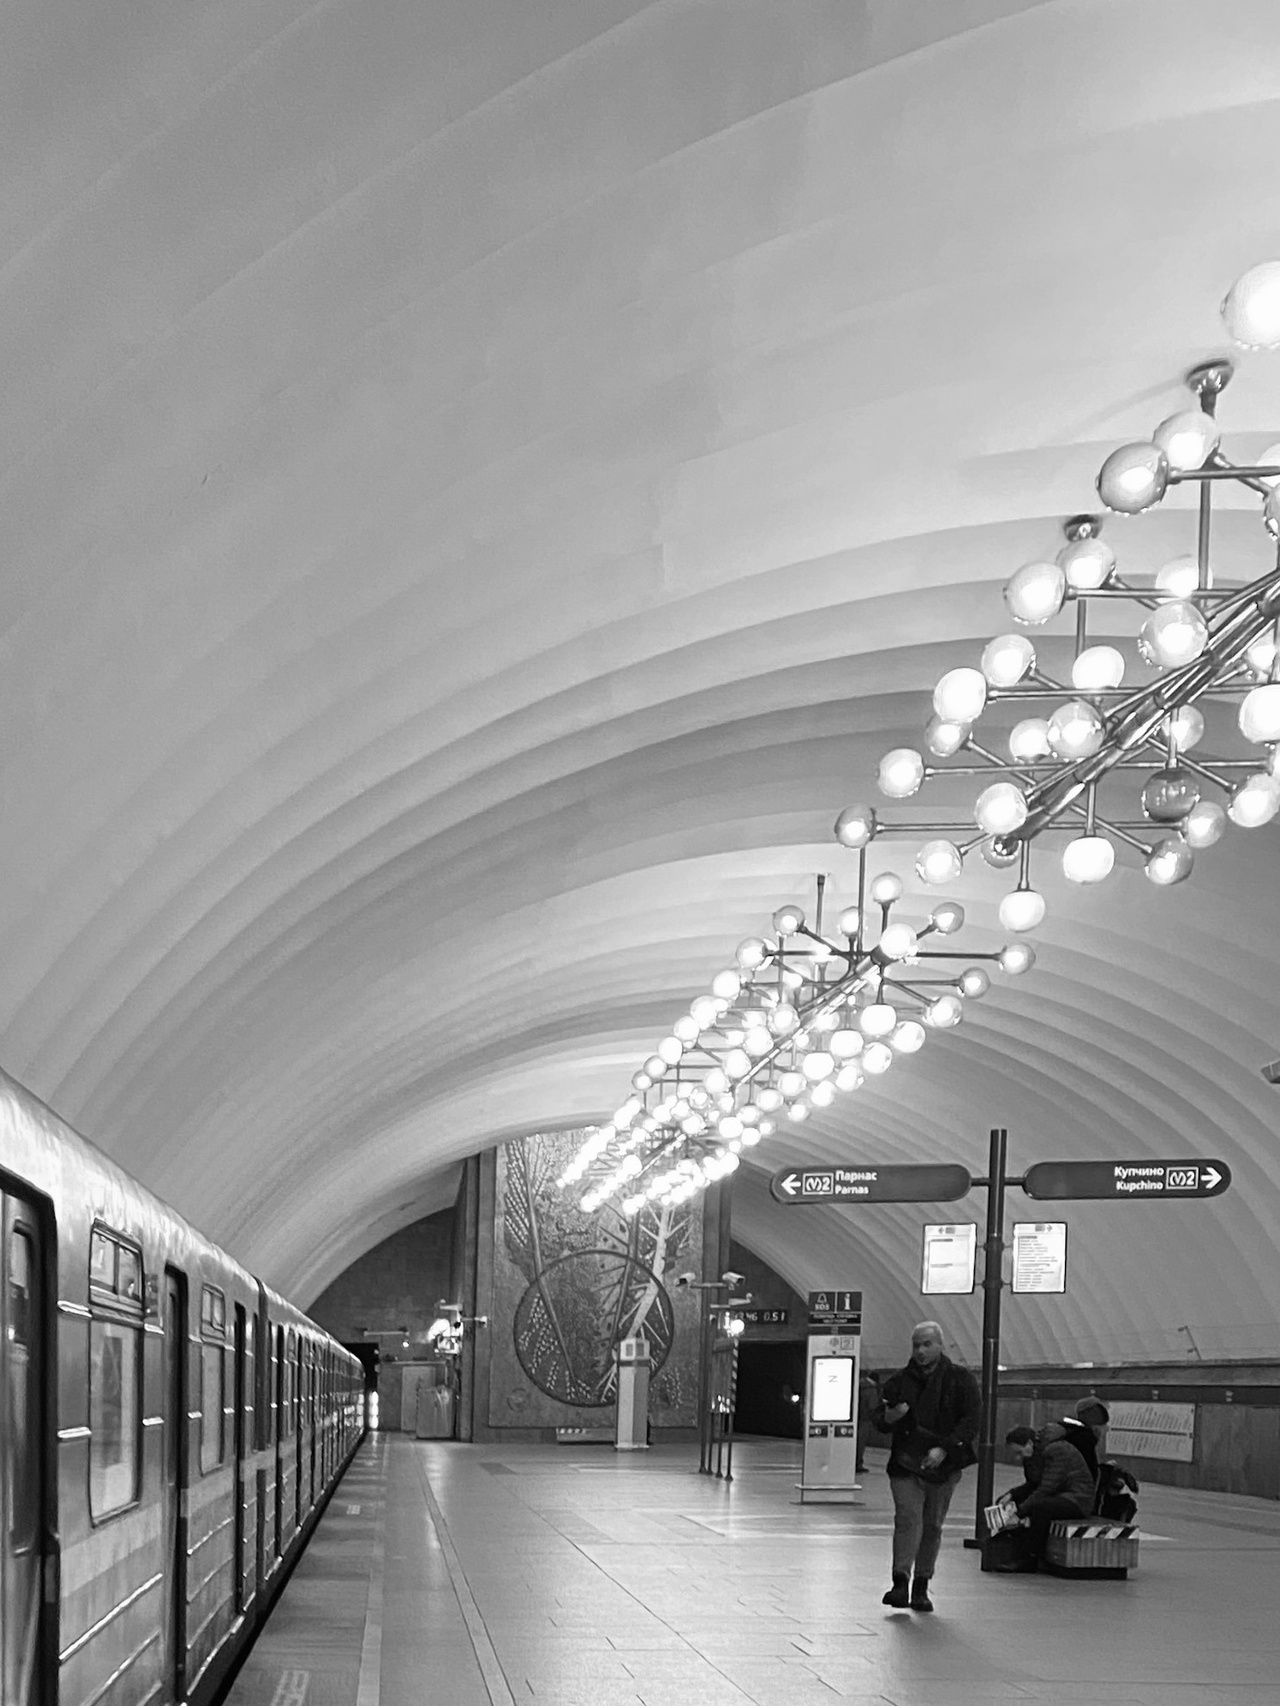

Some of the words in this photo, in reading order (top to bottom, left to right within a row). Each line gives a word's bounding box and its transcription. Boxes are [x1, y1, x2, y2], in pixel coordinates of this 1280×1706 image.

[835, 1170, 877, 1183] Парнас
[1114, 1166, 1164, 1179] Купчино
[835, 1184, 869, 1195] Parnas
[1116, 1180, 1163, 1192] Kupchino
